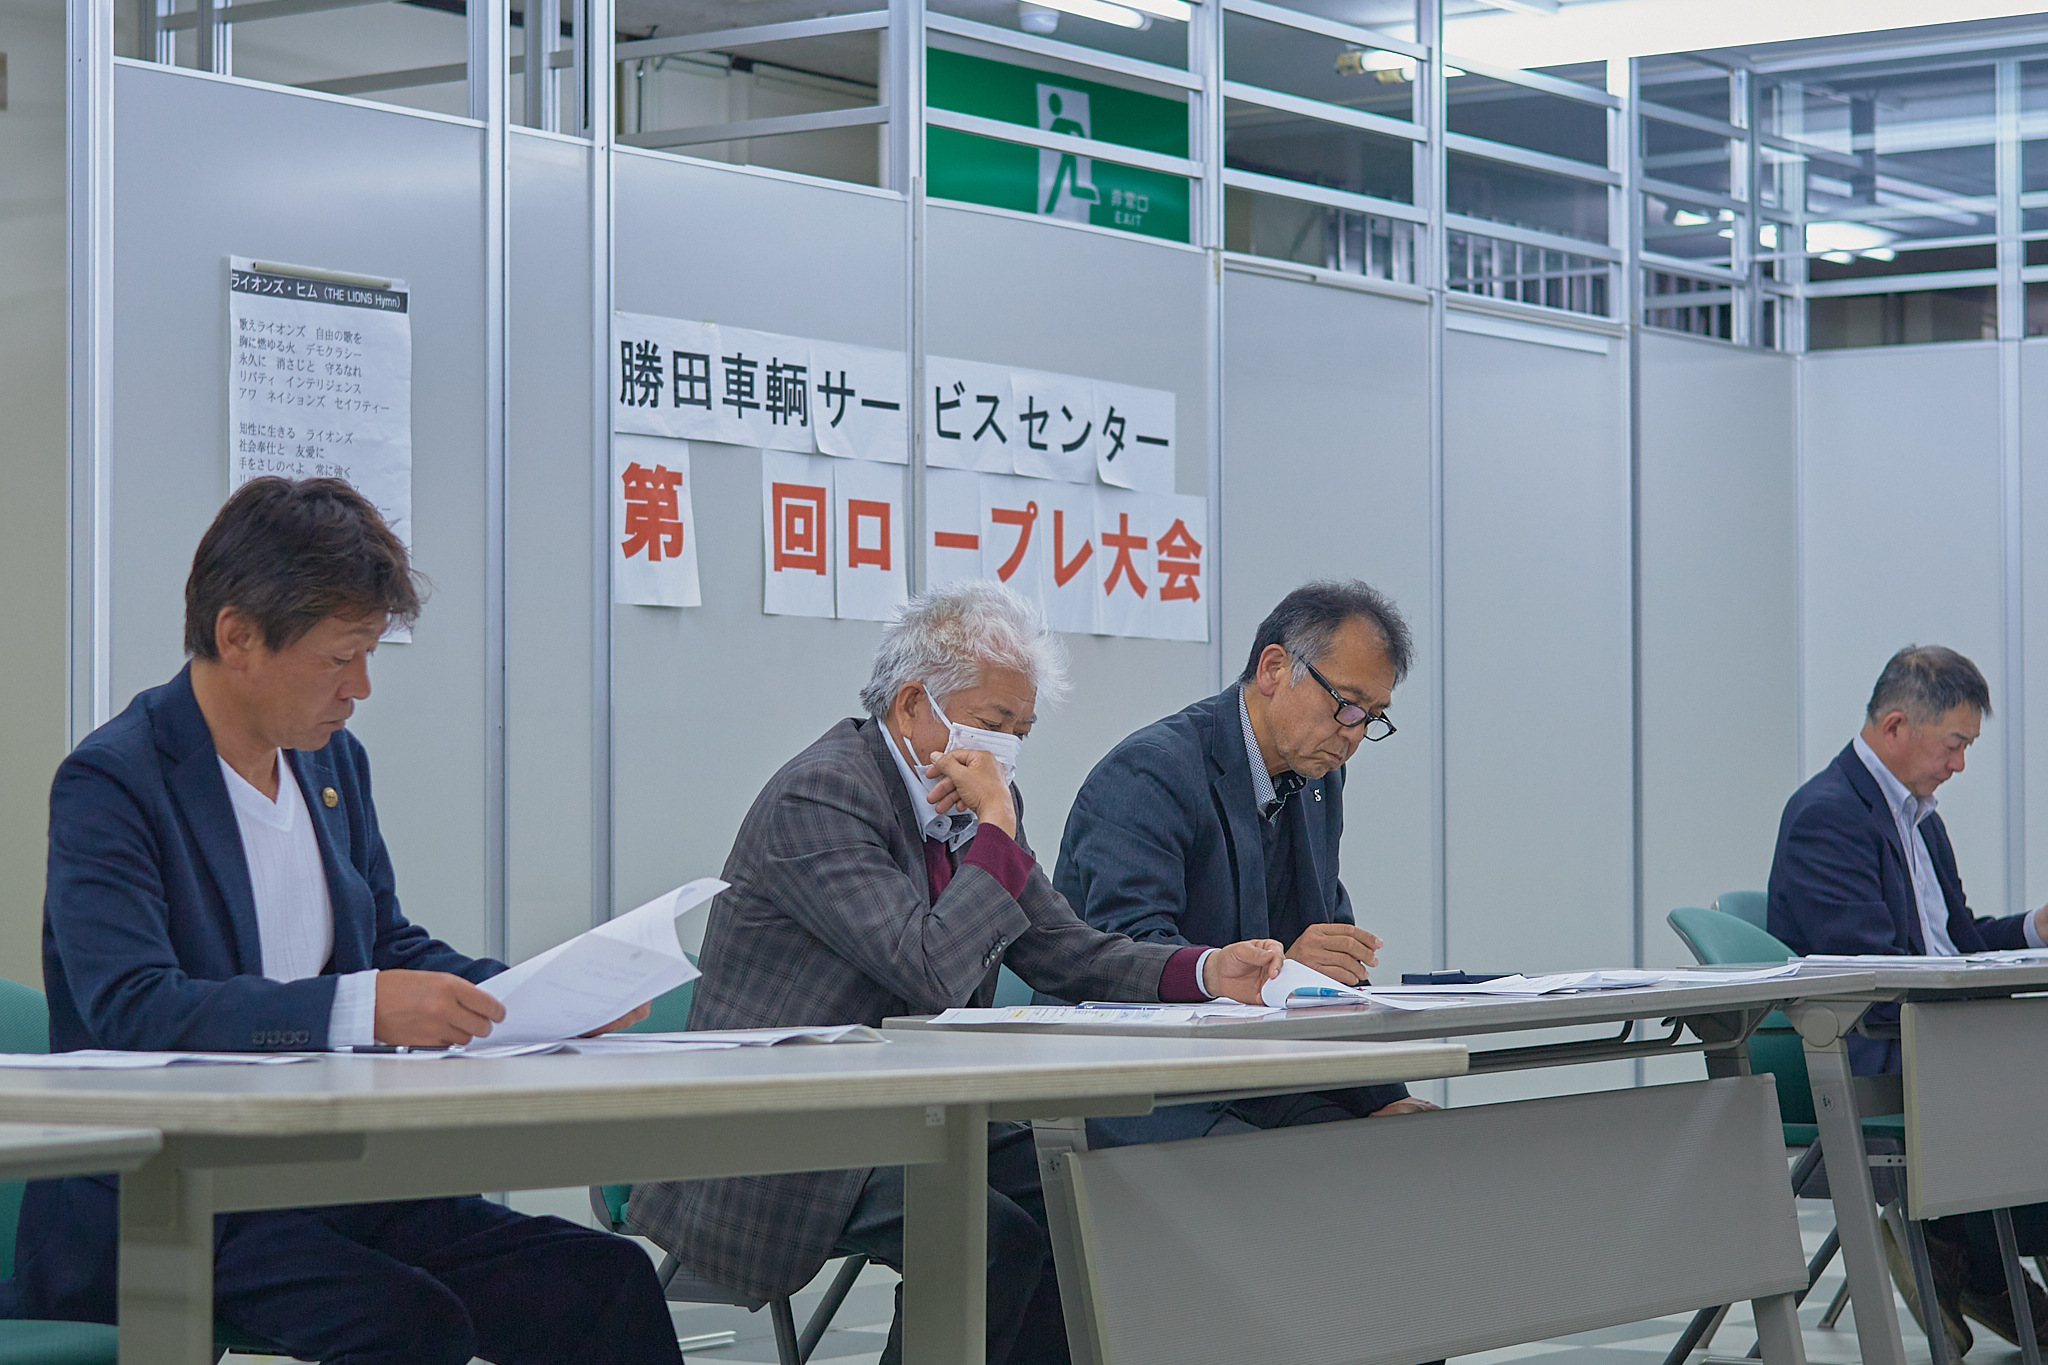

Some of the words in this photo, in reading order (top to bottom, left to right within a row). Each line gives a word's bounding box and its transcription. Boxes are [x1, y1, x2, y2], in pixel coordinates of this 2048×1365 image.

[1111, 189, 1149, 212] 非常口
[1114, 211, 1142, 226] EXIT
[231, 273, 318, 298] ライオンズ・ヒム
[347, 290, 373, 305] LIONS
[239, 317, 306, 337] 歌えライオンズ
[316, 327, 362, 345] 自由の歌を
[239, 335, 296, 354] 胸に燃ゆる火
[306, 343, 362, 360] デモクラシー
[238, 352, 267, 368] 永久に
[276, 357, 316, 373] 消さじと
[325, 362, 363, 378] 守るなれ
[286, 376, 362, 394] インテリジェンス
[239, 388, 257, 400] アワ
[267, 390, 326, 408] ネイションズ
[334, 397, 390, 414] セイフティー
[239, 421, 296, 439] 知性に生きる
[306, 429, 354, 445] ライオンズ
[239, 439, 286, 455] 社会奉仕と
[295, 443, 325, 459] 友愛に
[239, 457, 305, 475] 手をさしのべよ
[315, 464, 351, 478] 常に強く
[621, 461, 683, 562] 第
[772, 482, 1203, 605] 回ロープレ大会
